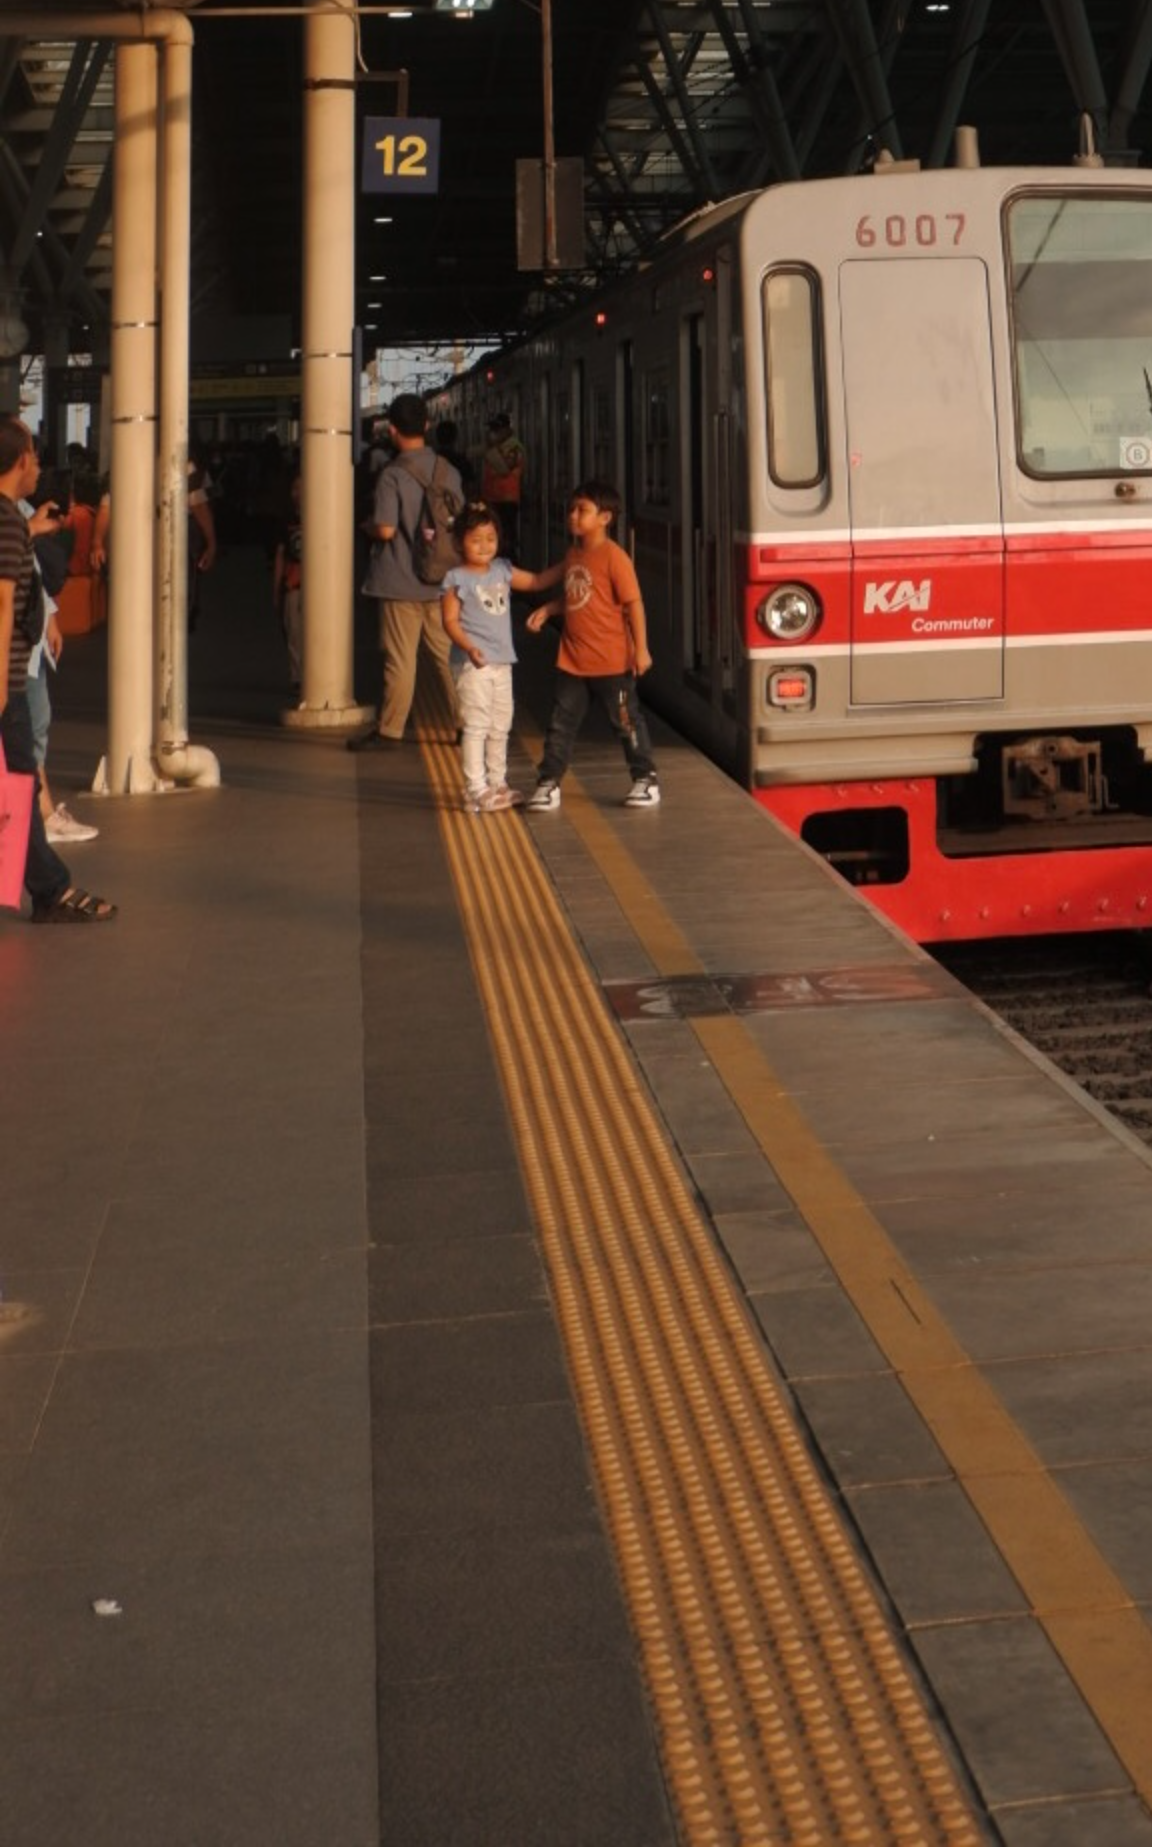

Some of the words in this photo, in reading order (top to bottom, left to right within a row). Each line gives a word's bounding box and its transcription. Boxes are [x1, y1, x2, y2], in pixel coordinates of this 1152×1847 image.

[375, 135, 427, 176] 12
[856, 213, 965, 247] 6007
[863, 579, 931, 614] KAI
[911, 617, 994, 633] Commuter
